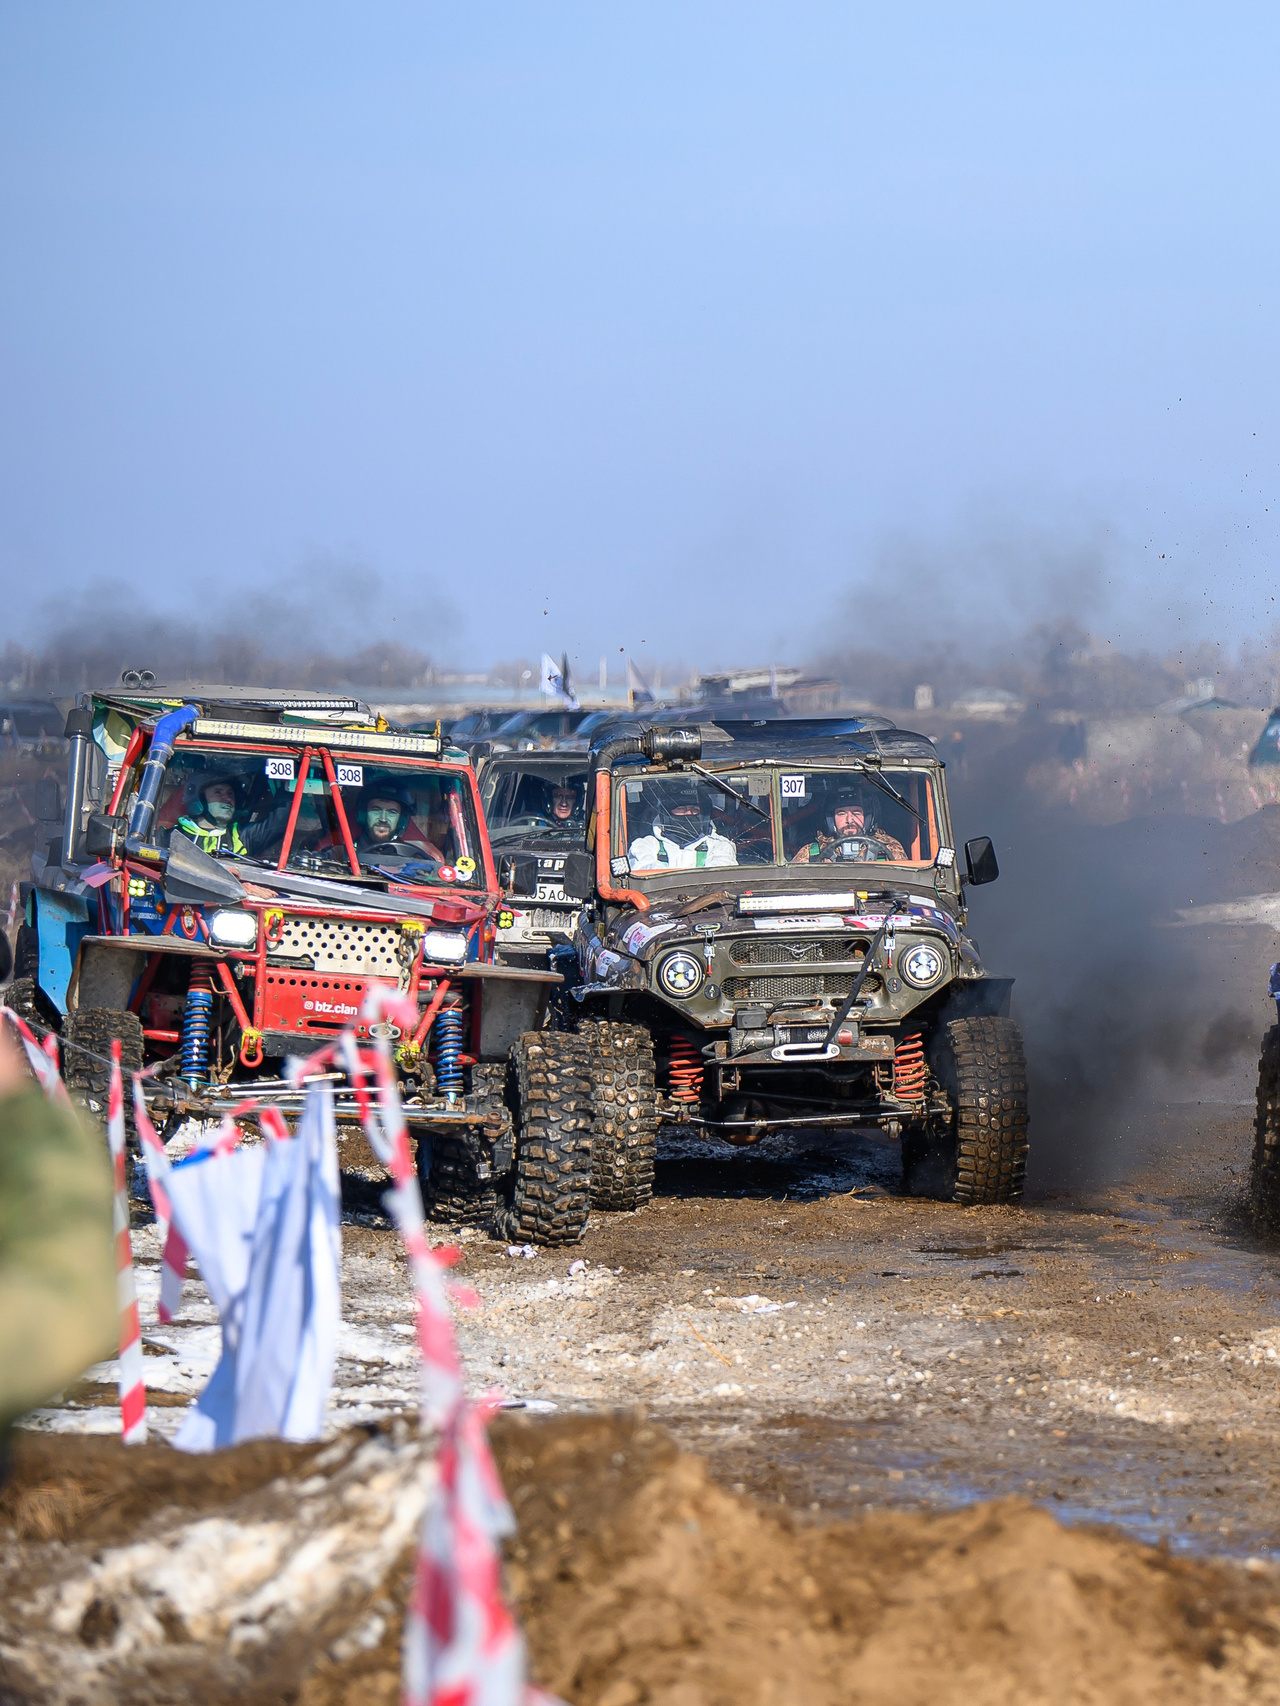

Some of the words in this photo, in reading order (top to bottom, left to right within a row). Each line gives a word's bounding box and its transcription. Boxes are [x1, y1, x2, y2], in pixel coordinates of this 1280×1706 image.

[270, 762, 292, 776] 308
[339, 768, 361, 783] 308
[783, 779, 804, 793] 307
[314, 1000, 358, 1016] btz.clan
